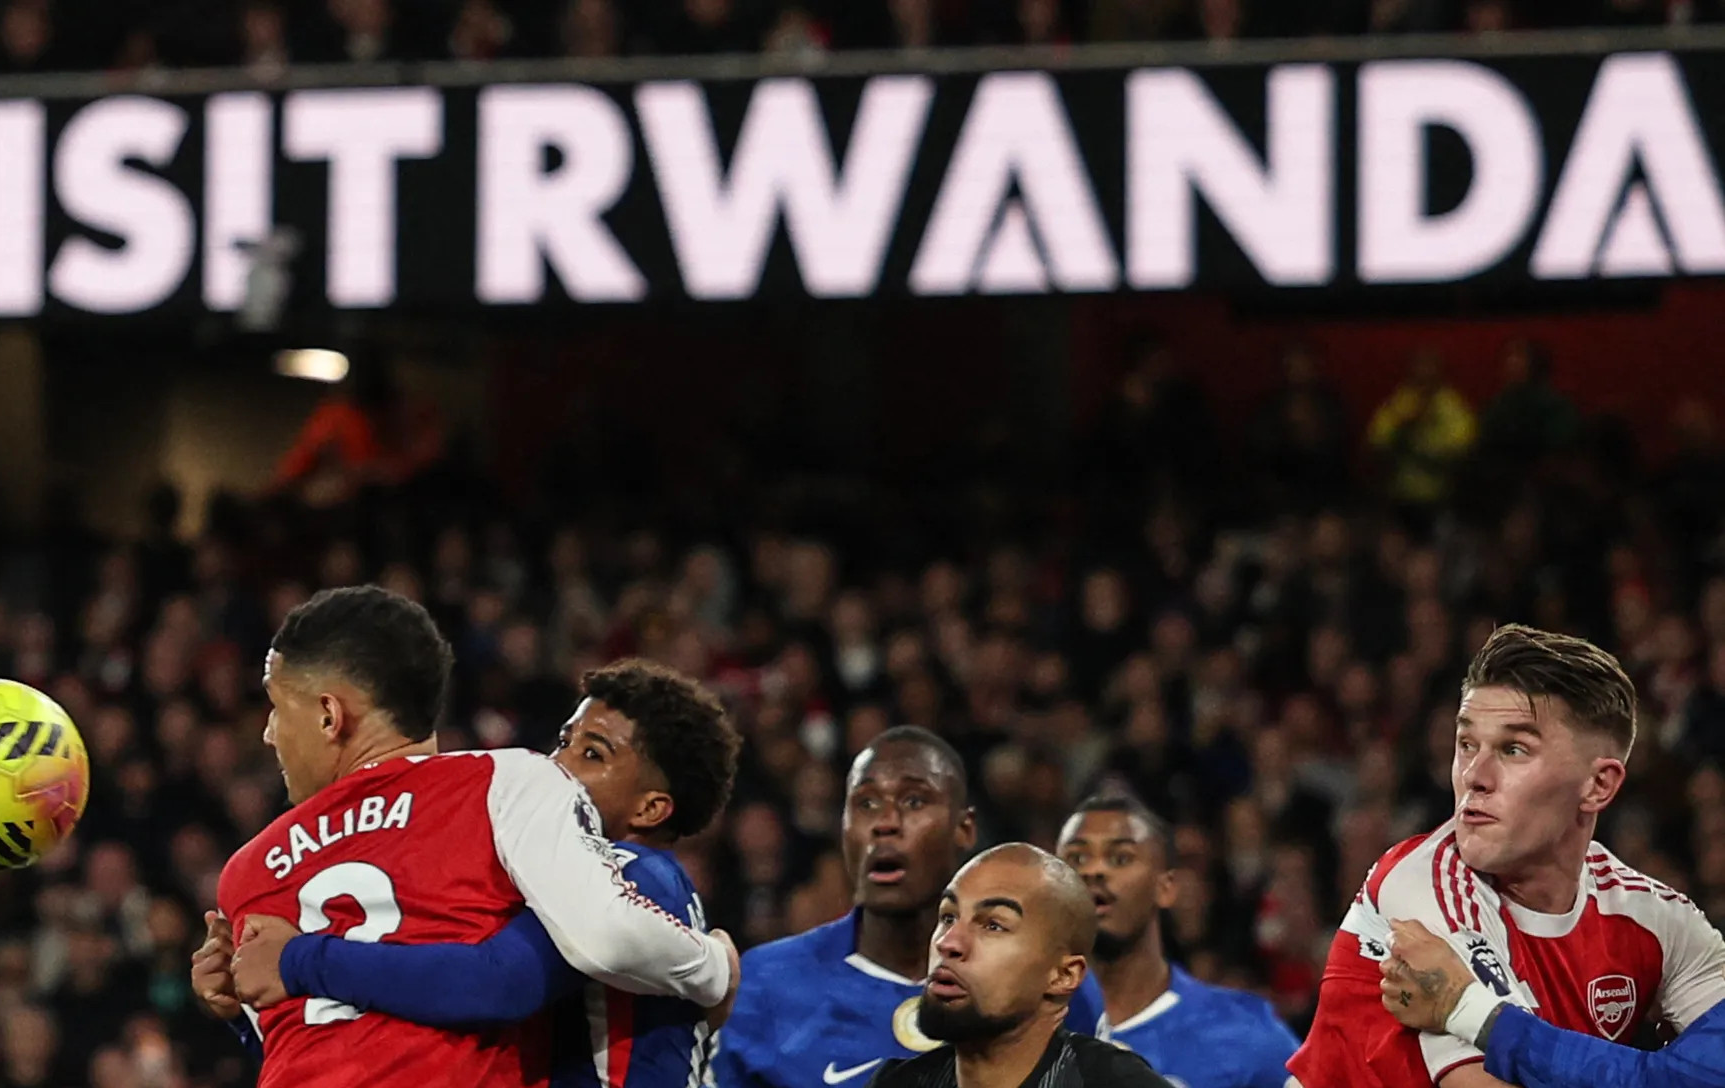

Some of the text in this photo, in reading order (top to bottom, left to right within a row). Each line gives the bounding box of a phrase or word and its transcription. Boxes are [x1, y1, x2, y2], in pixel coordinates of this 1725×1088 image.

[475, 50, 1725, 305] RWANDA
[264, 791, 414, 880] SALIBA
[1594, 986, 1630, 999] Arsenal
